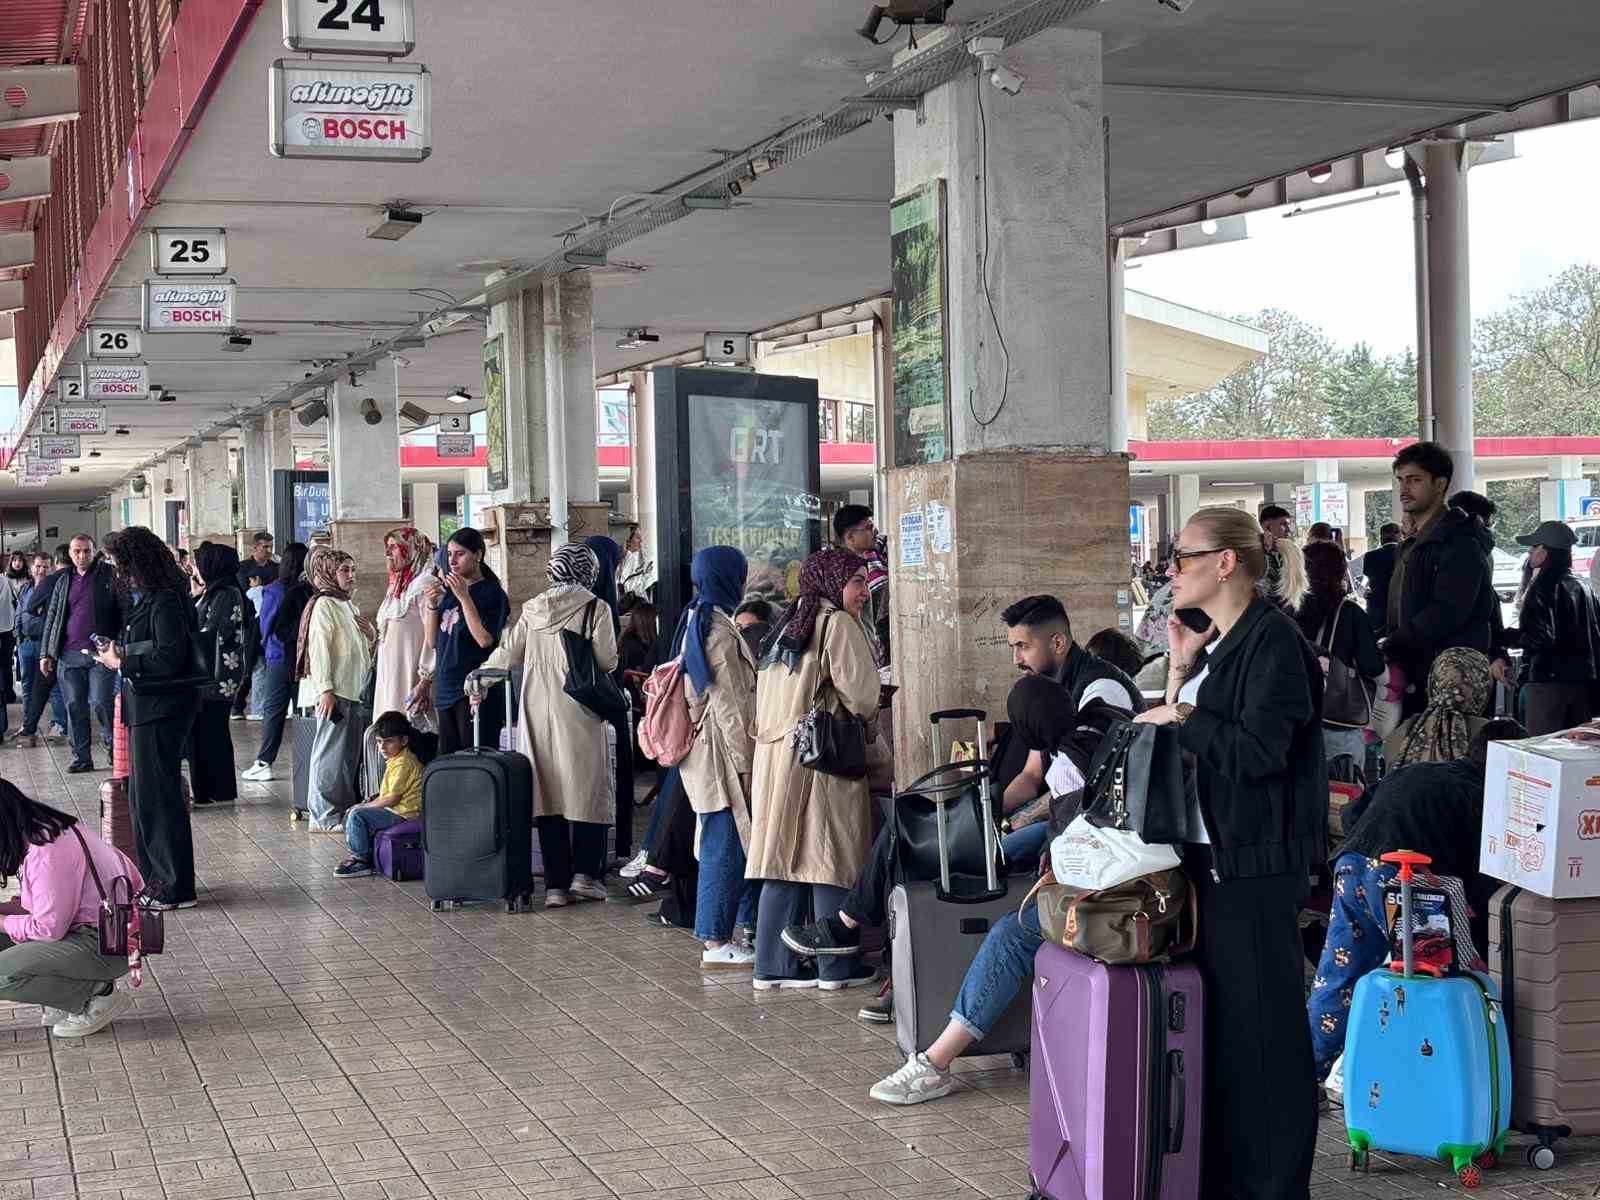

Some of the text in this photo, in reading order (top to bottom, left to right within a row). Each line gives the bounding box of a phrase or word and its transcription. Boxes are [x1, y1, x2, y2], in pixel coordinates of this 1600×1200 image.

[317, 0, 385, 32] 24
[323, 118, 406, 140] BOSCH
[170, 239, 210, 263] 25
[172, 310, 222, 322] BOSCH
[100, 332, 129, 350] 26
[722, 340, 735, 355] 5
[68, 383, 82, 396] 2
[102, 384, 138, 393] BOSCH
[70, 422, 98, 430] BOSCH
[452, 417, 460, 428] 3
